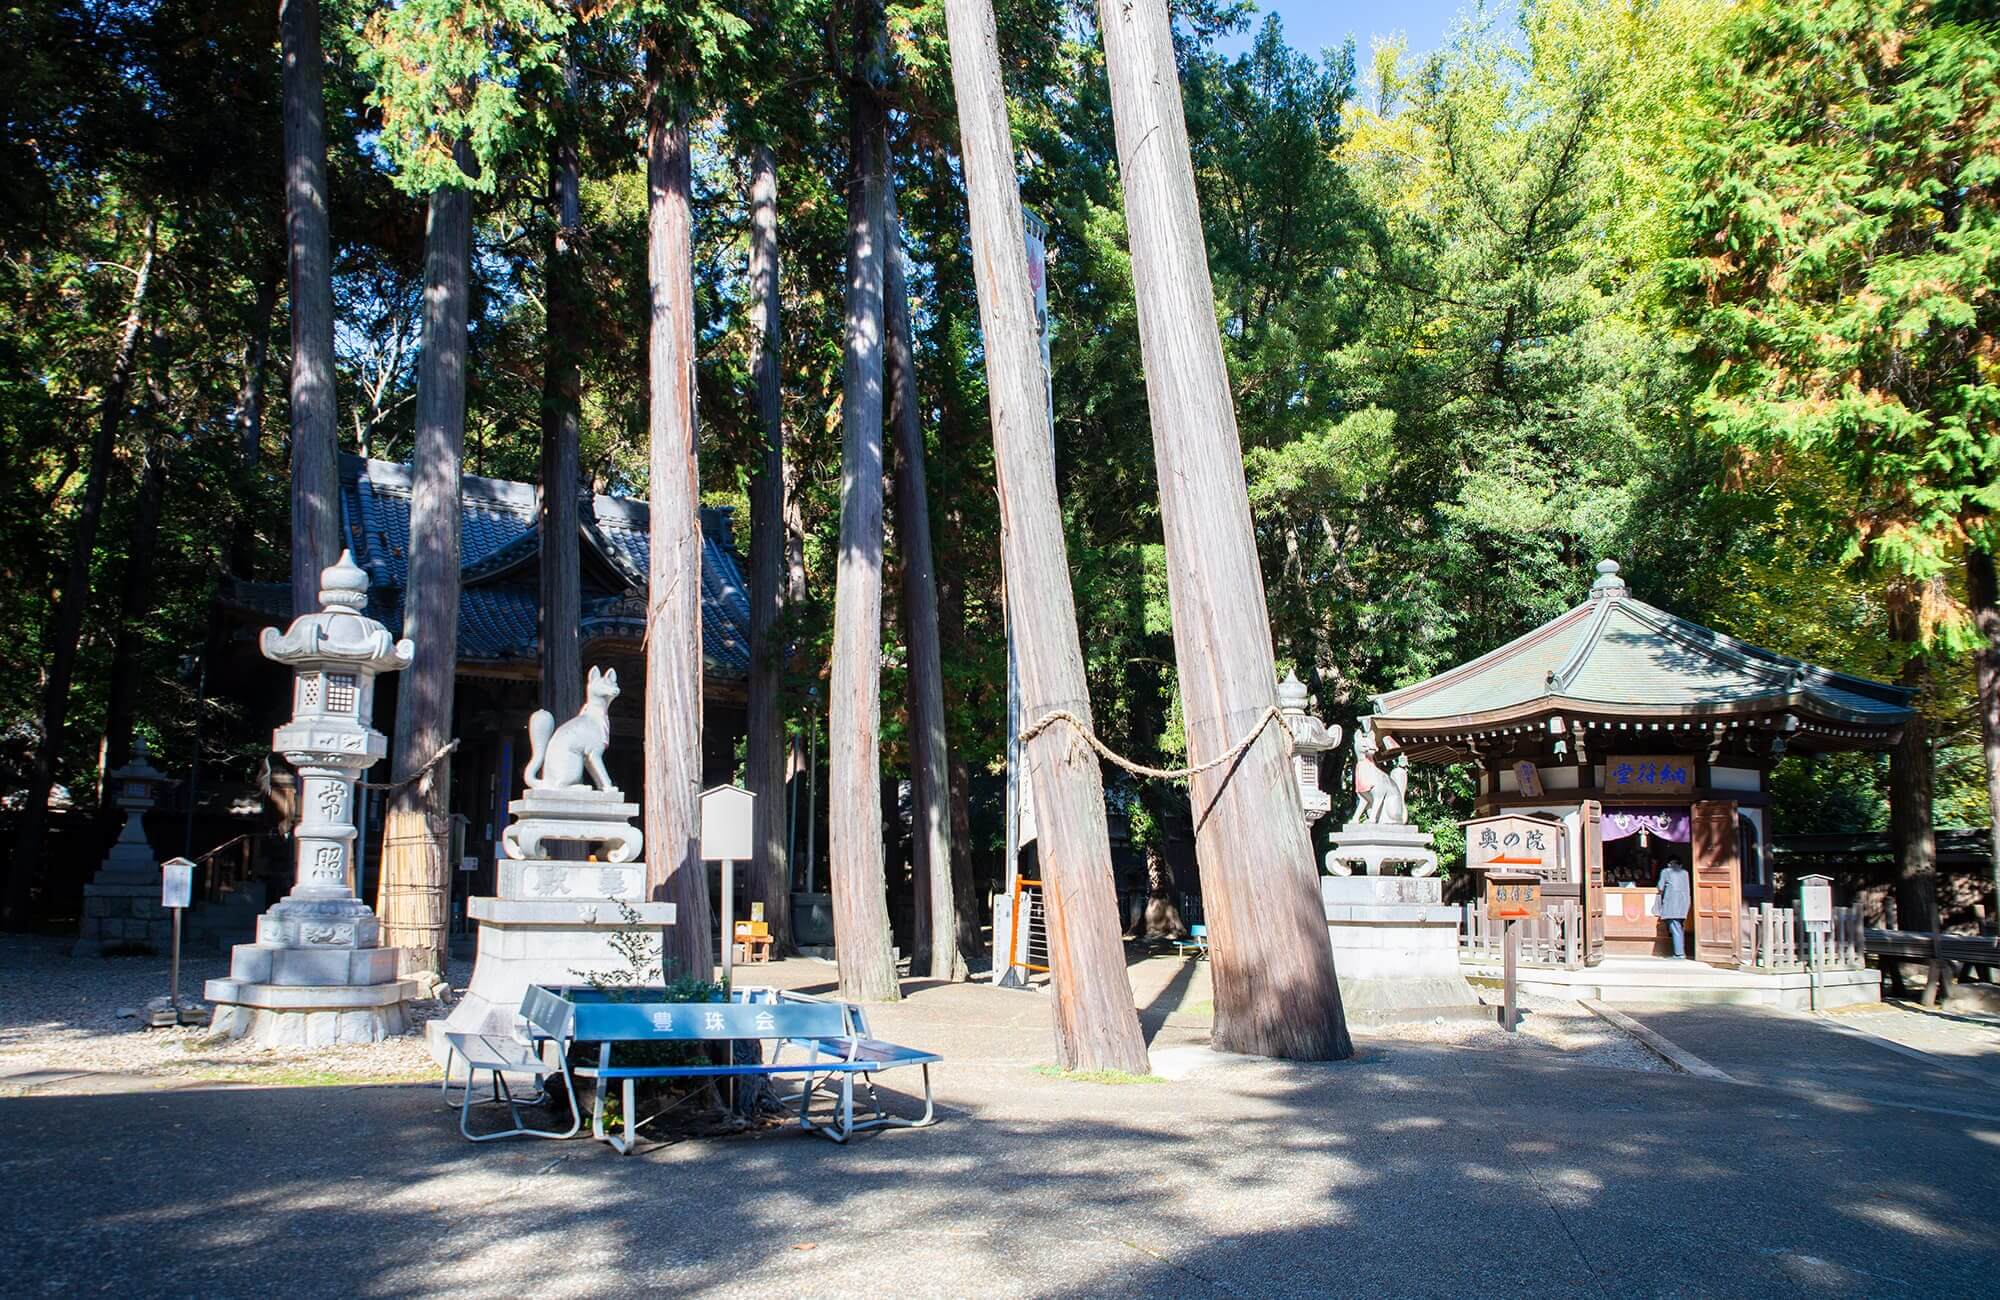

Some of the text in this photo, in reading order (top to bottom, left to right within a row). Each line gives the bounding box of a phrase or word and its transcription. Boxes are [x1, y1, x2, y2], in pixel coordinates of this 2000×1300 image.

[1478, 827, 1546, 851] 奥の院
[653, 1011, 776, 1032] 豊珠会
